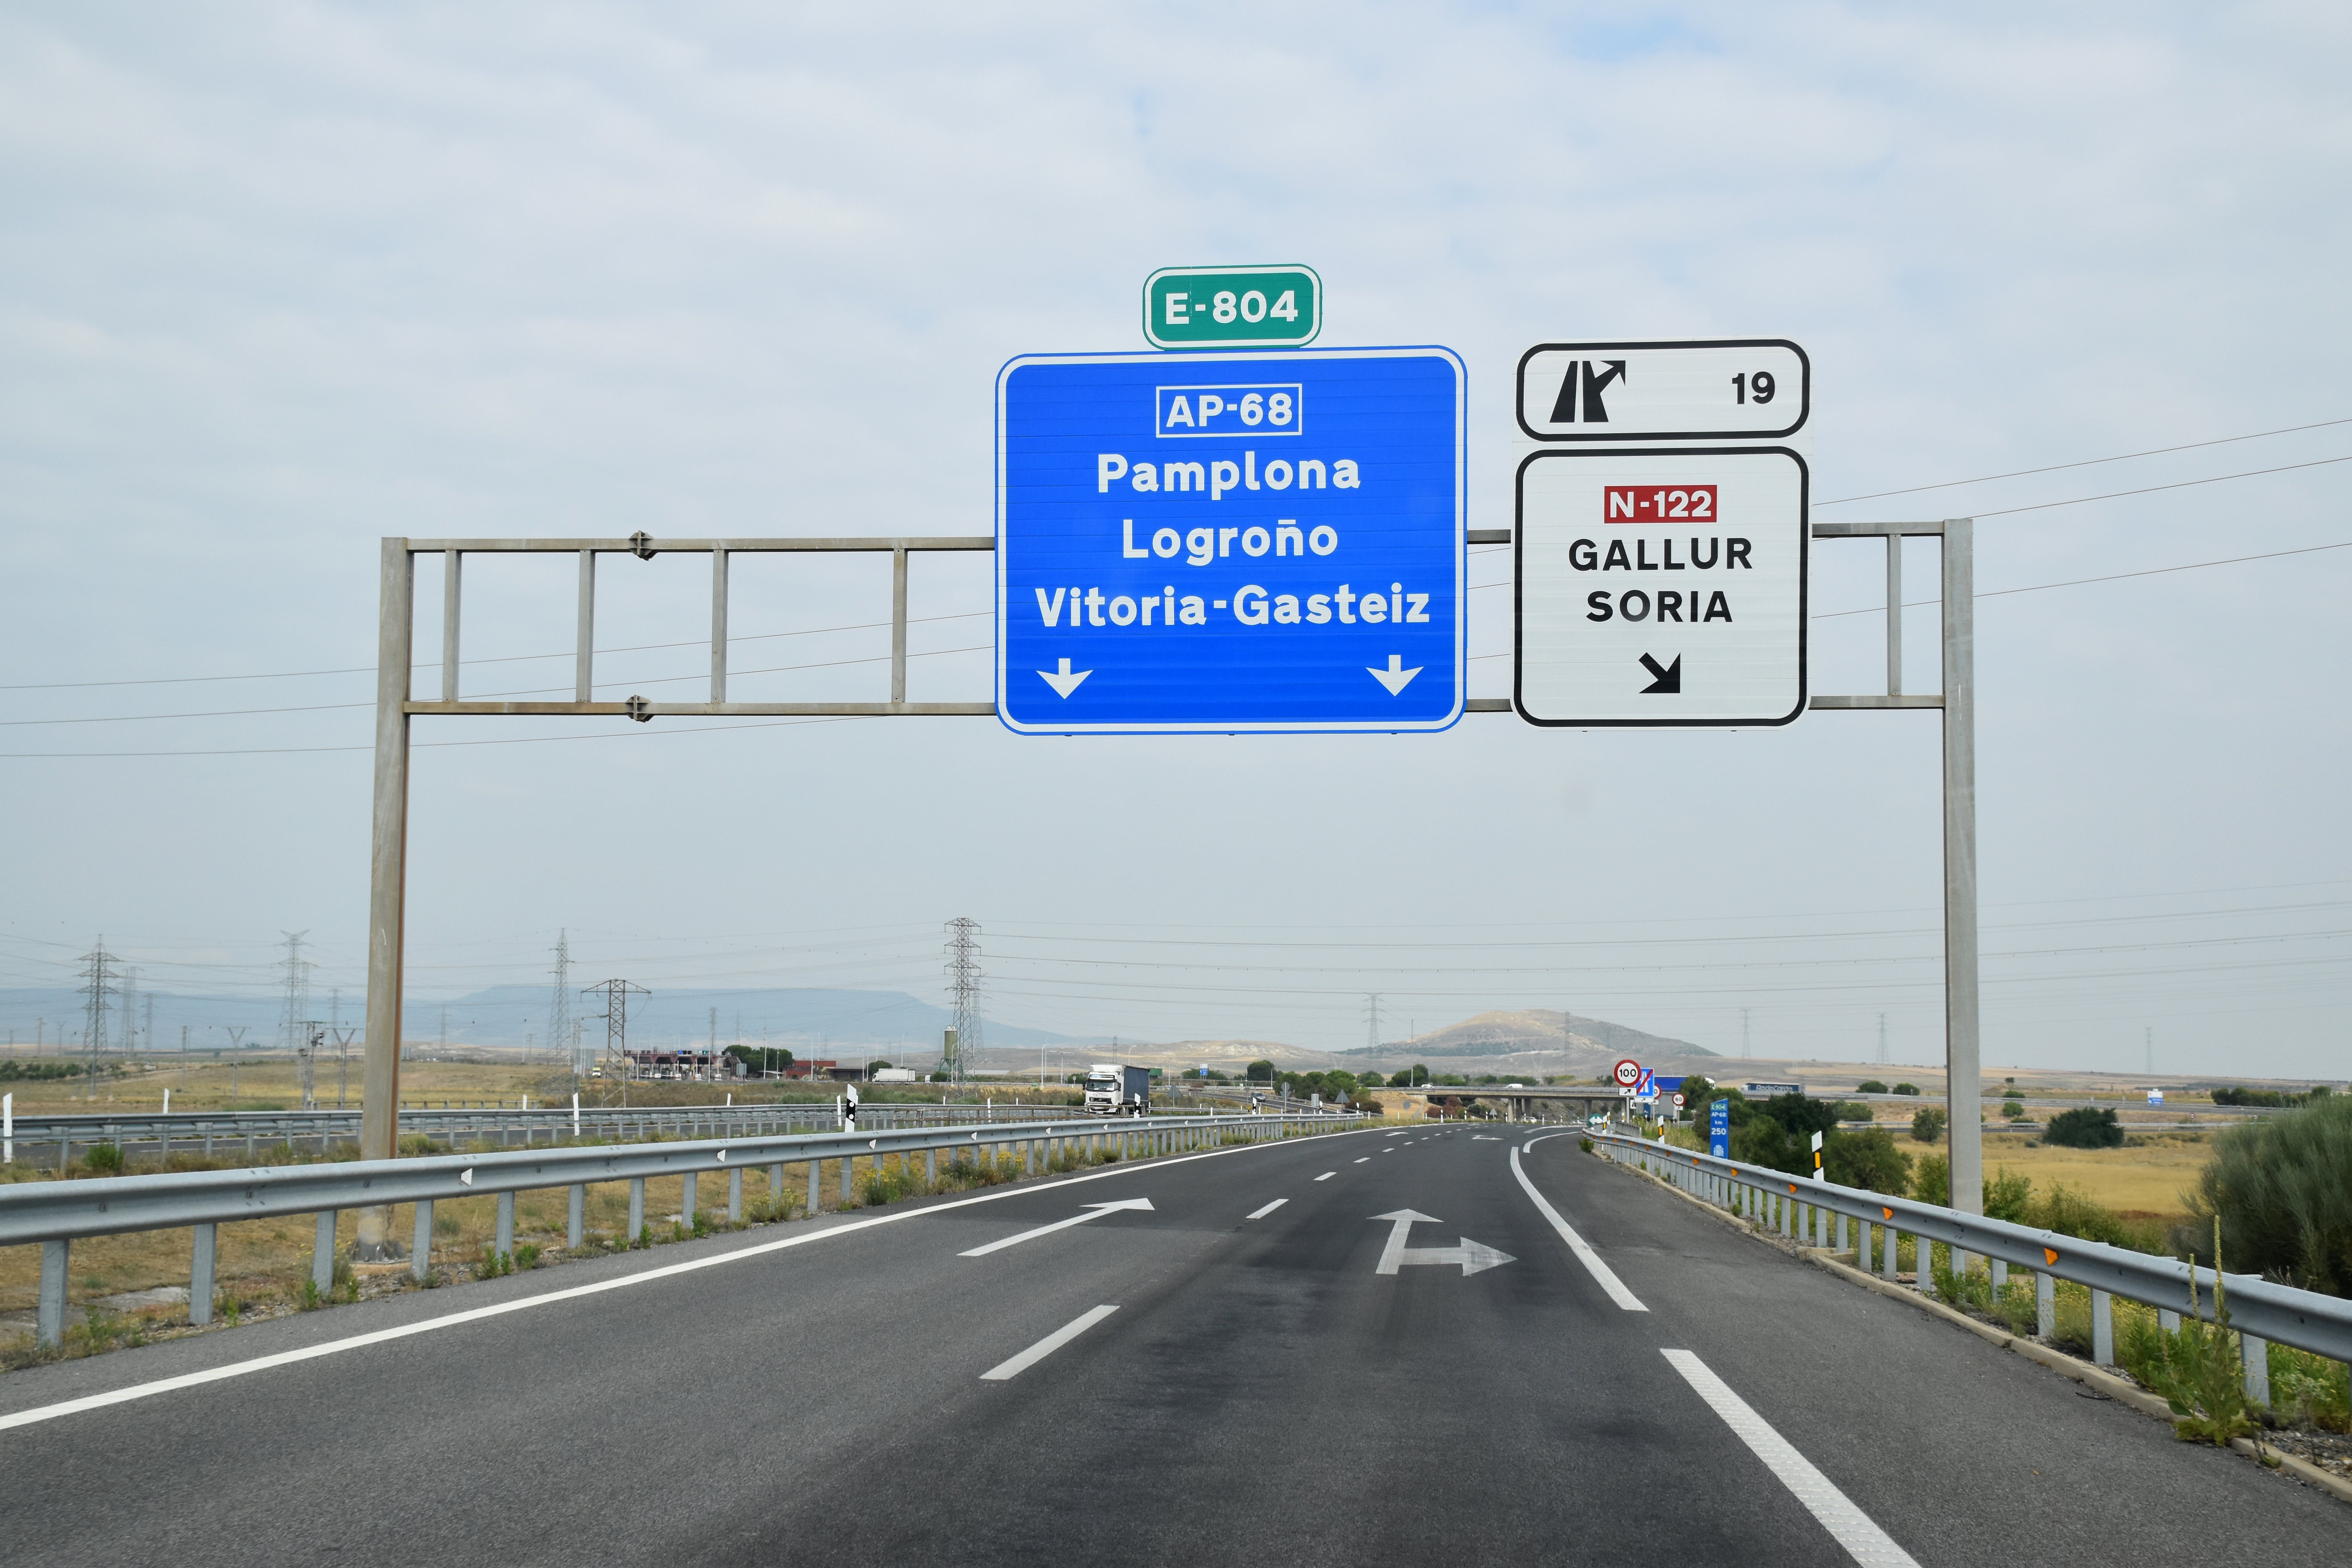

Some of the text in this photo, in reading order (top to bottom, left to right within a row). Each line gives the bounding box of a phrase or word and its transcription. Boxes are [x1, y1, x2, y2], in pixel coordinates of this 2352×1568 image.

[1166, 290, 1298, 325] E-804
[1732, 371, 1775, 405] 19
[1166, 393, 1292, 427] AP-68
[1098, 451, 1361, 500] Pamplona
[1610, 490, 1711, 518] N-122
[1123, 519, 1338, 566] Logroño
[1569, 537, 1752, 571] GALLUR
[1035, 582, 1429, 627] Vitoria-Gasteiz
[1586, 590, 1733, 622] SORIA
